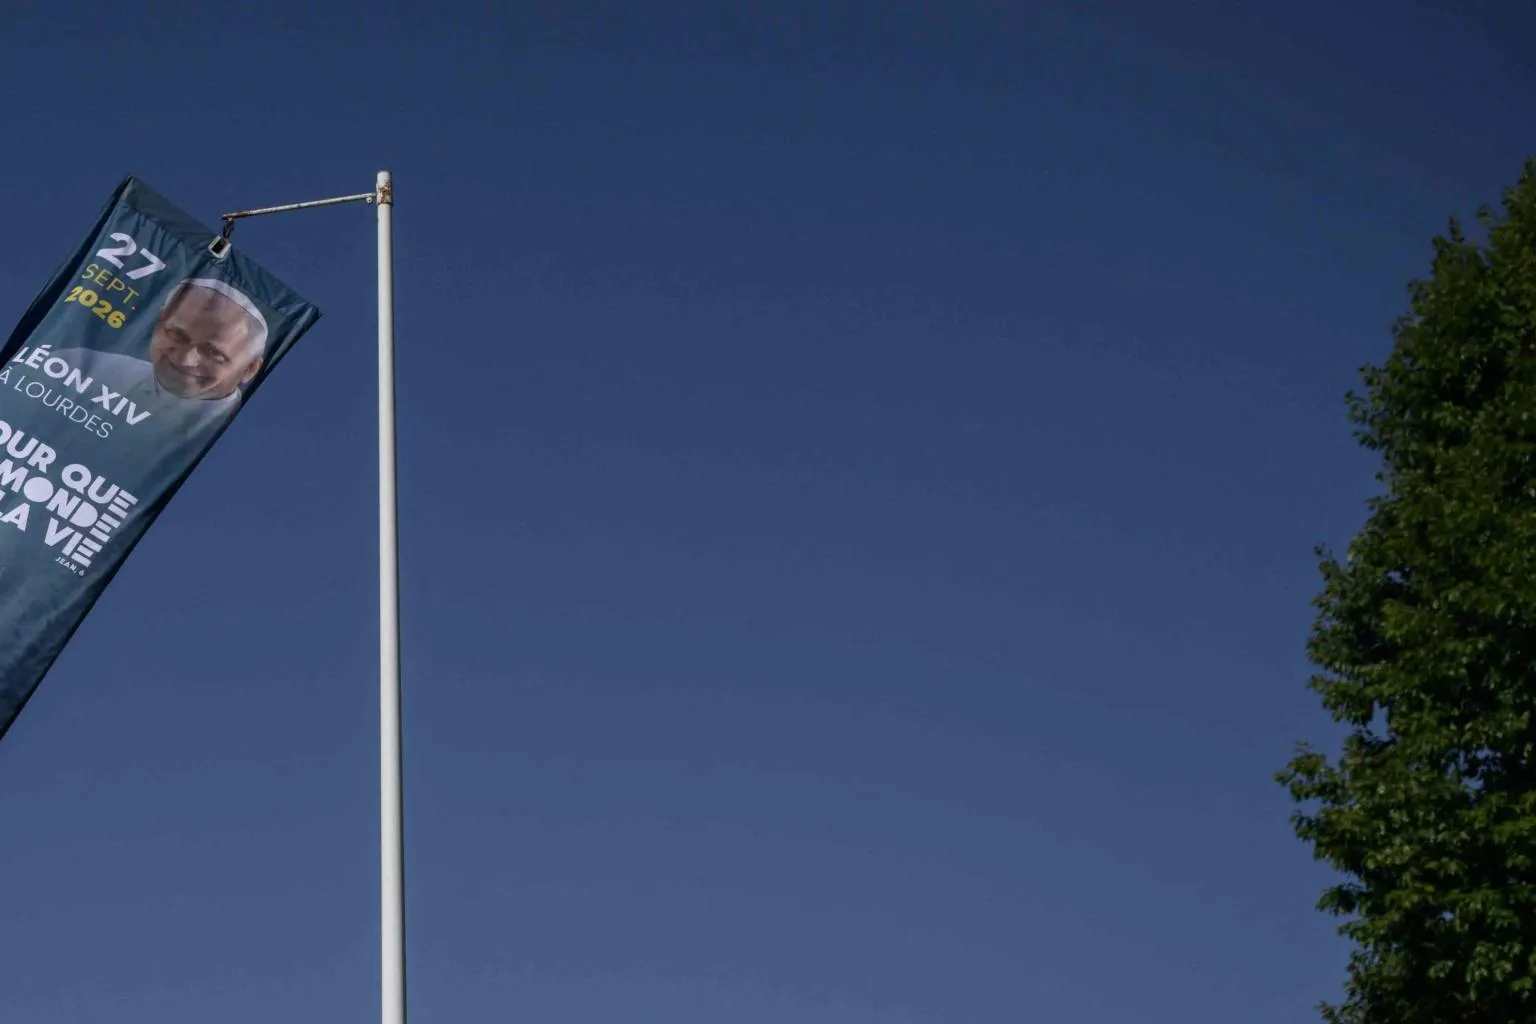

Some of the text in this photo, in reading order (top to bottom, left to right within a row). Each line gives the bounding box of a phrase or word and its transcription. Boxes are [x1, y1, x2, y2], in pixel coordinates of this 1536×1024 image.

[96, 232, 166, 280] 27
[64, 286, 126, 328] 2026
[81, 263, 140, 310] SEPT.
[12, 344, 151, 426] LÉON XIV
[14, 375, 113, 438] LOURDES
[62, 463, 139, 519] QUE
[44, 517, 103, 568] VIE
